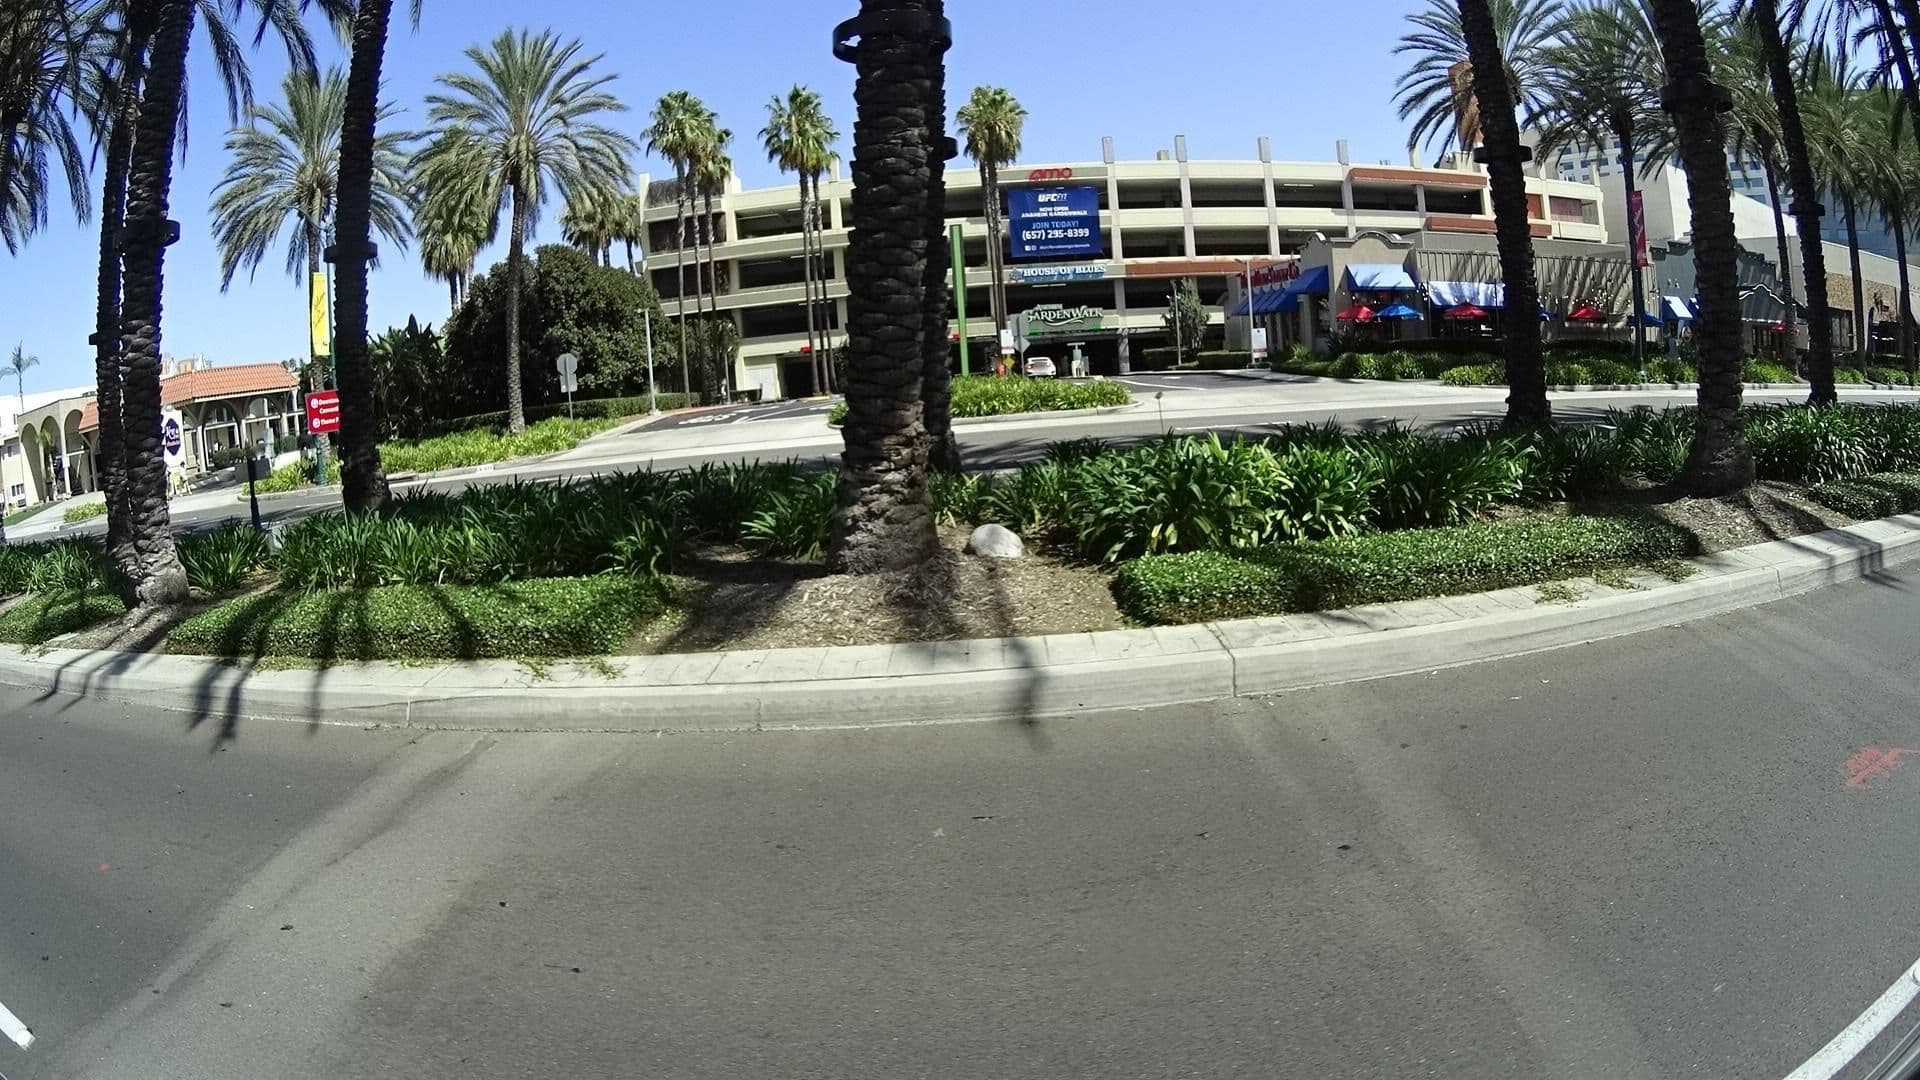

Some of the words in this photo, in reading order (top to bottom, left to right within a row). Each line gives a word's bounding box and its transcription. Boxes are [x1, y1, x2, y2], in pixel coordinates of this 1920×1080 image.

[1032, 221, 1050, 229] JOIN
[1051, 220, 1079, 228] TODAY!
[1022, 229, 1046, 241] (657)
[1047, 228, 1090, 239] 295-8399
[1023, 267, 1056, 277] HOUSE
[1059, 266, 1071, 275] OF
[1075, 264, 1106, 274] BLUES
